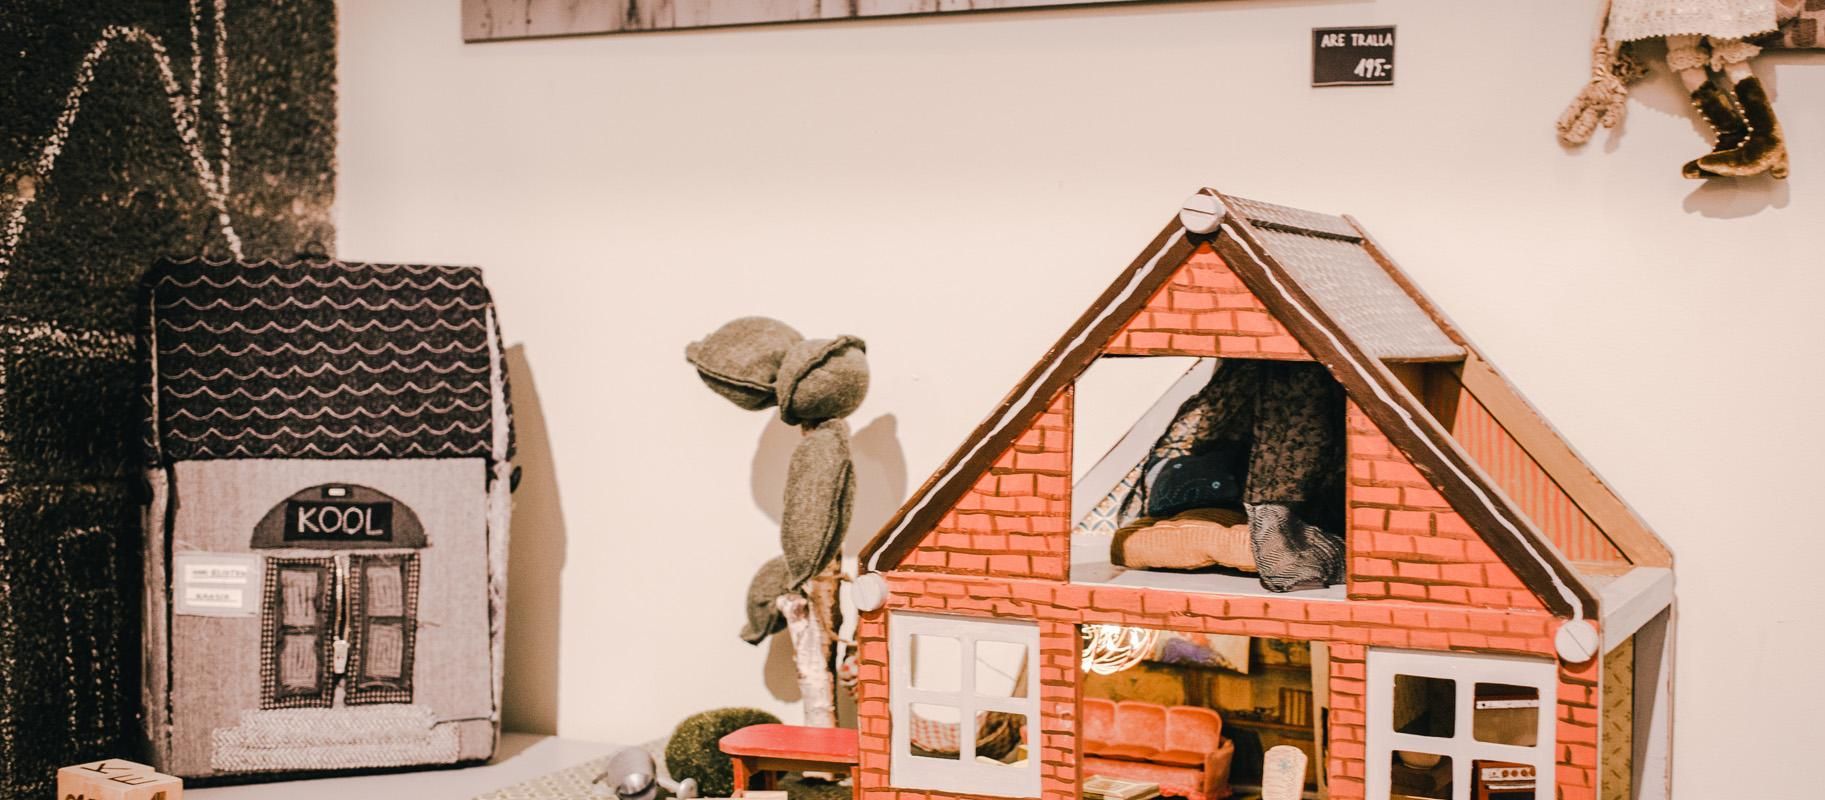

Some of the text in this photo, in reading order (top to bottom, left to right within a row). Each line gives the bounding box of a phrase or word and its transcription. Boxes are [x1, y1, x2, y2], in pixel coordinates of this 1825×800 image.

[1321, 33, 1393, 48] ARE TRALLA
[298, 506, 383, 536] KOOL
